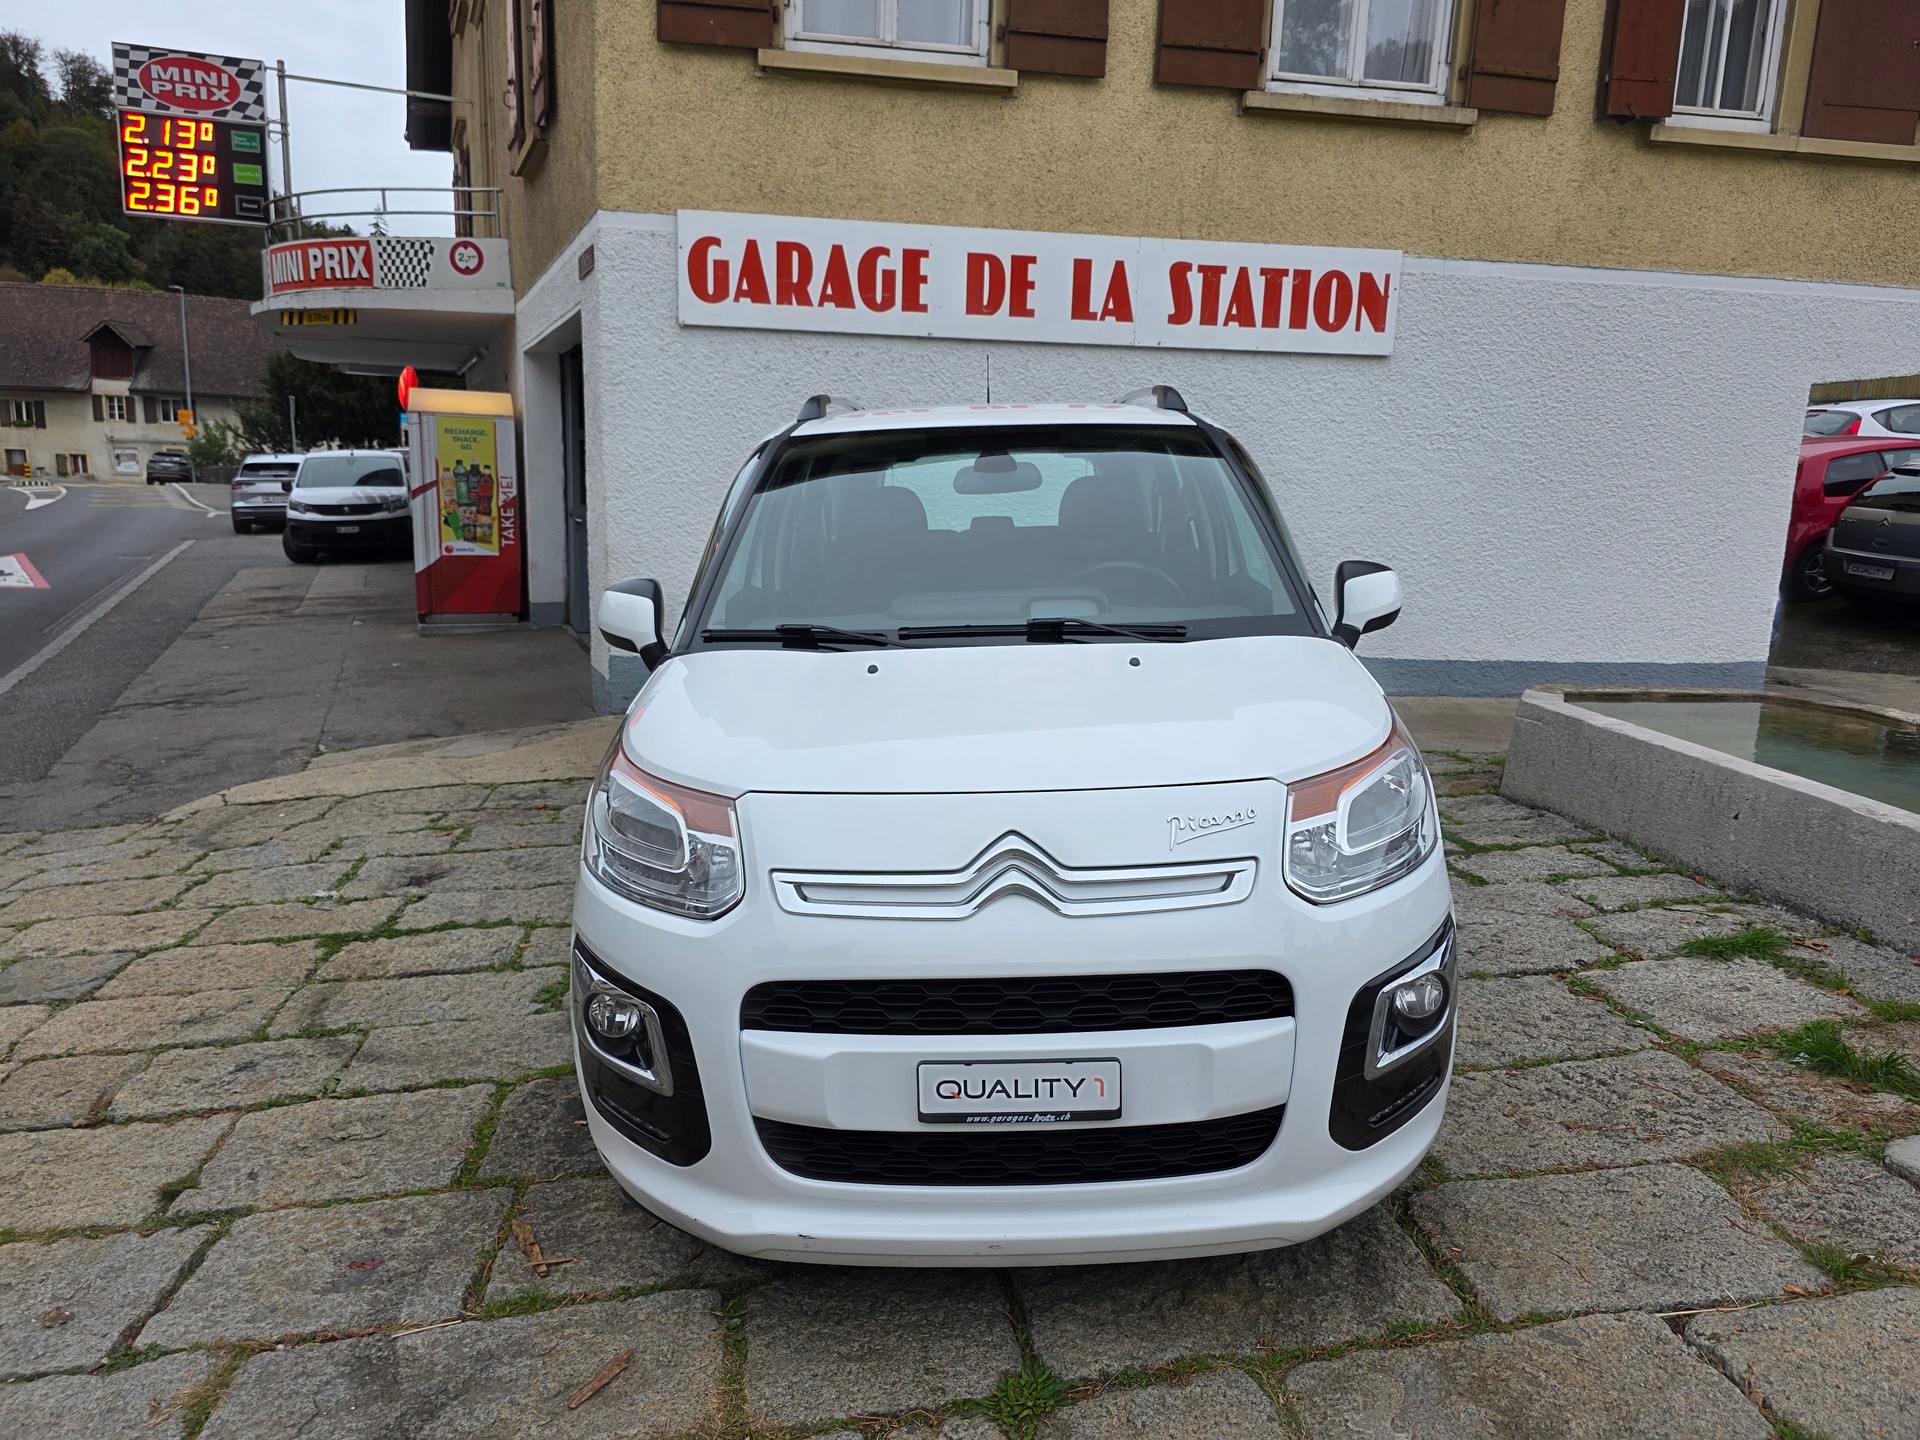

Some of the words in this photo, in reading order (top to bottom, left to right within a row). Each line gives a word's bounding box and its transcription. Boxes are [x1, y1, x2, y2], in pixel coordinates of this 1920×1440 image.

[150, 64, 230, 88] MINI
[151, 82, 231, 103] PRIX
[271, 250, 304, 285] MINI
[308, 245, 370, 280] PRIX
[687, 235, 930, 313] GARAGE
[966, 252, 1037, 318] DE
[1071, 257, 1134, 323] LA
[1168, 260, 1391, 334] STATION
[444, 427, 488, 437] RECHARGE.
[452, 436, 480, 444] SNACK.
[500, 475, 514, 503] ME!
[501, 507, 515, 548] TAKE
[936, 1078, 1087, 1100] QUALITY
[1094, 1077, 1105, 1097] 1
[966, 1112, 1071, 1123] www.garages-hotz.ch
